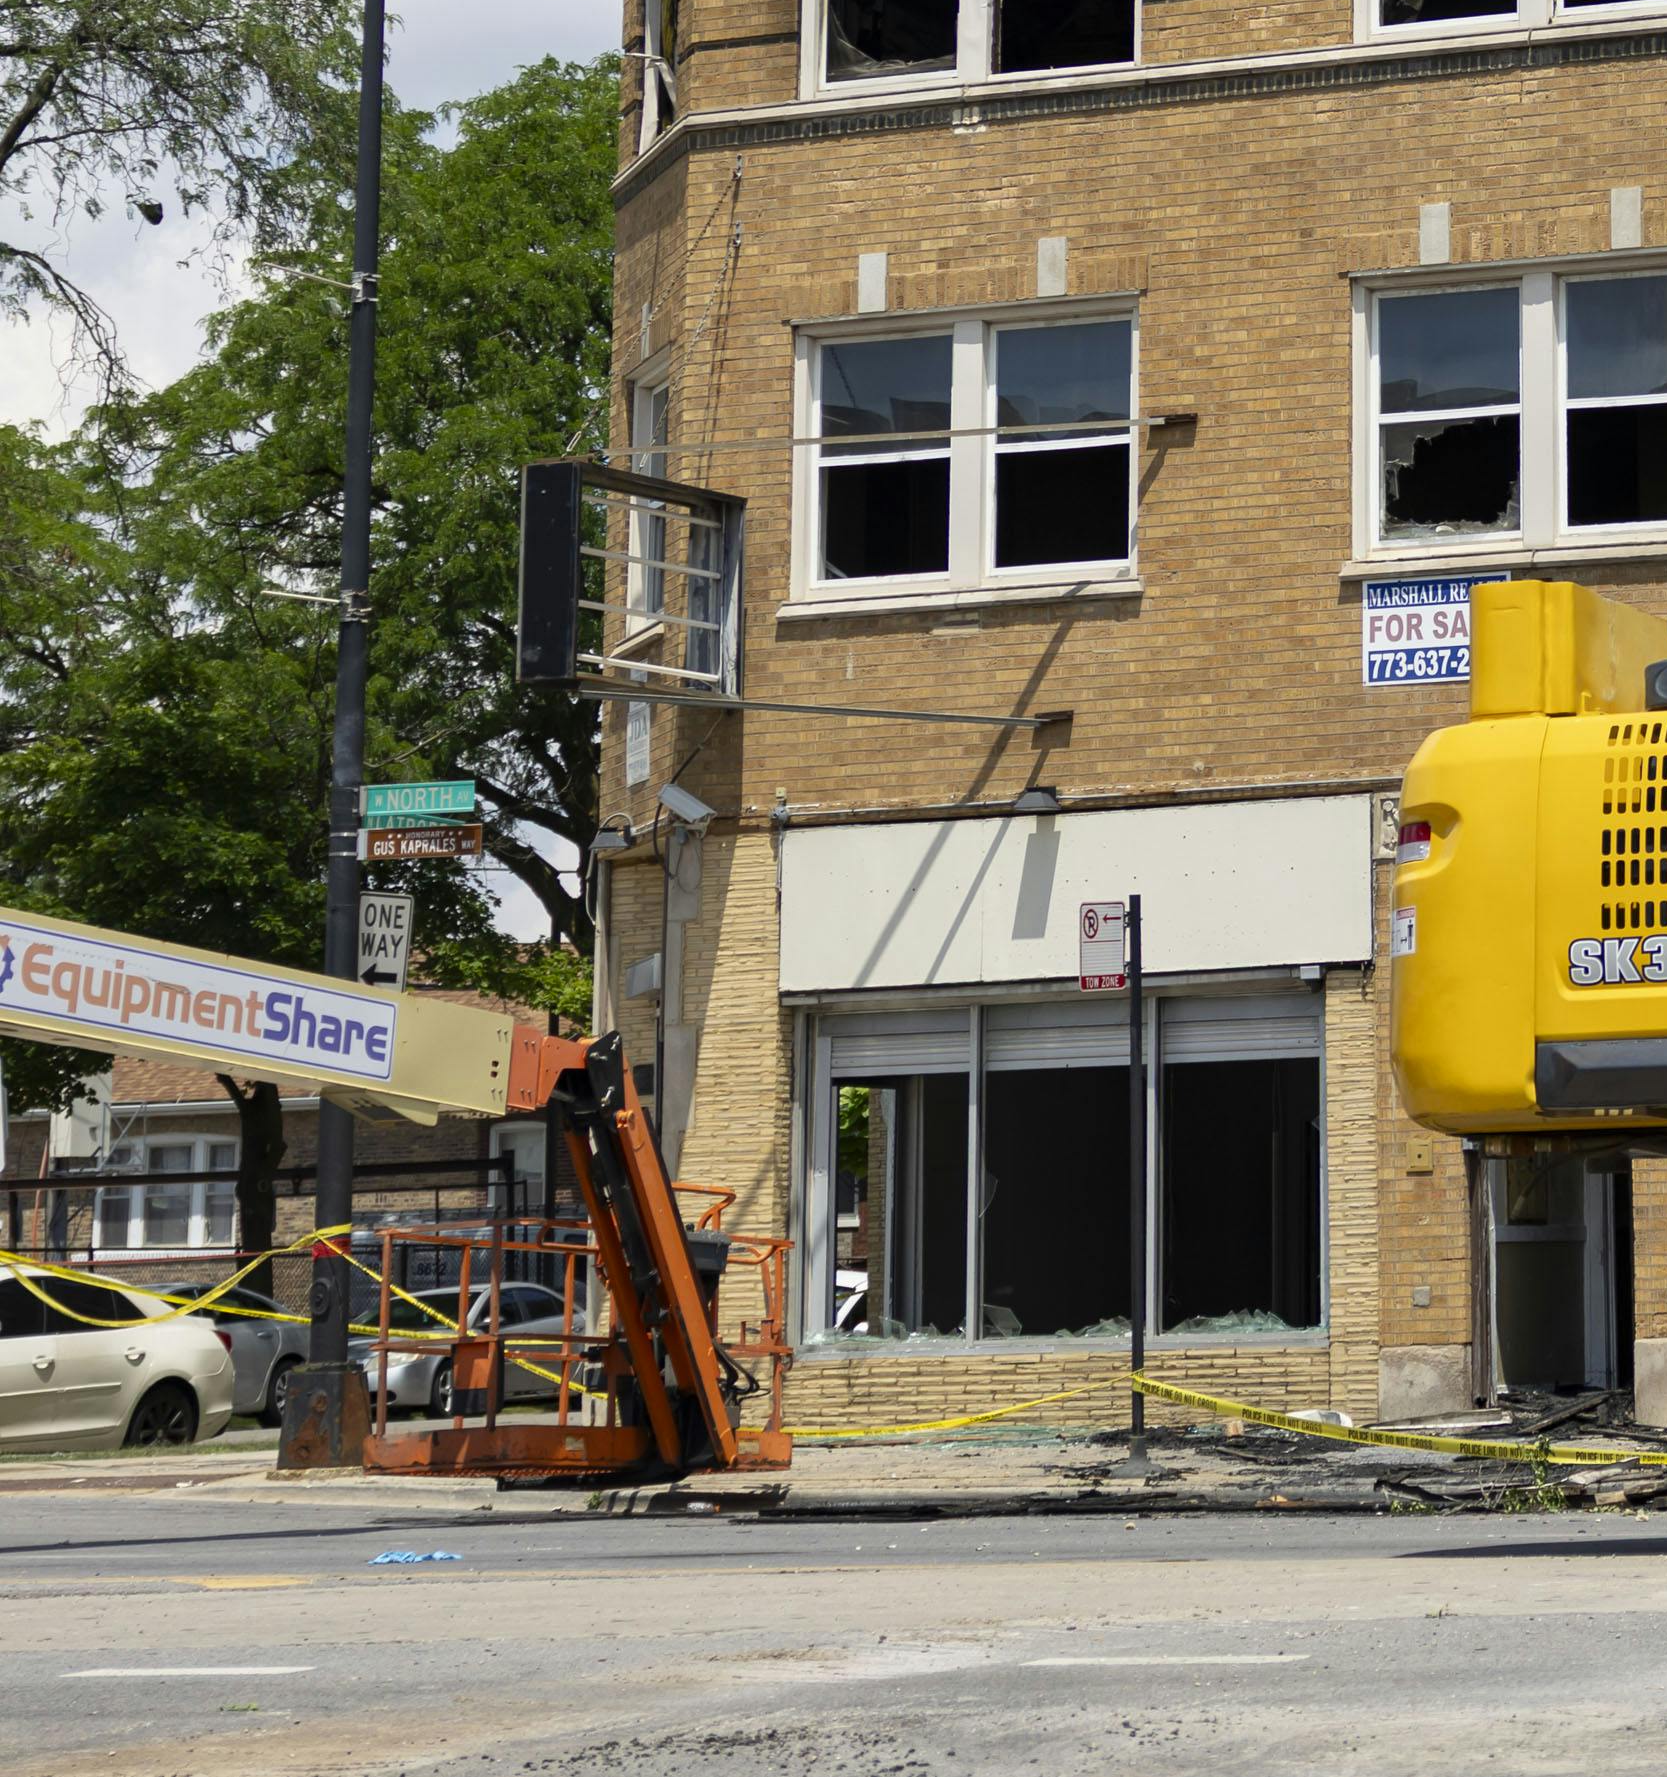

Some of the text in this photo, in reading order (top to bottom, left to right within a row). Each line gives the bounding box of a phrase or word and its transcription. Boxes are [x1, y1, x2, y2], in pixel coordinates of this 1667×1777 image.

[1369, 584, 1447, 608] MARSHALL
[1369, 610, 1469, 643] FOR SA
[1370, 648, 1470, 679] 773-637-2
[387, 787, 452, 811] NORTH
[373, 838, 476, 856] GUS KAPRALES WAY
[405, 830, 446, 840] HONORARY
[364, 903, 405, 929] ONE
[361, 932, 404, 958] WAY
[1085, 976, 1119, 988] TOW ZONE
[21, 942, 389, 1063] EquipmentShare
[1141, 1382, 1218, 1411] POLICE LINE DO NOT CROSS
[1242, 1408, 1322, 1433] POLICE LINE DO NOT CROSS
[1348, 1429, 1433, 1450] POLICE LINE DO NOT CROSS
[1460, 1443, 1481, 1454] POLICE
[1483, 1445, 1496, 1456] LINE
[1498, 1447, 1508, 1457] DO
[1575, 1452, 1597, 1461] POLICE
[1600, 1453, 1613, 1461] LINE
